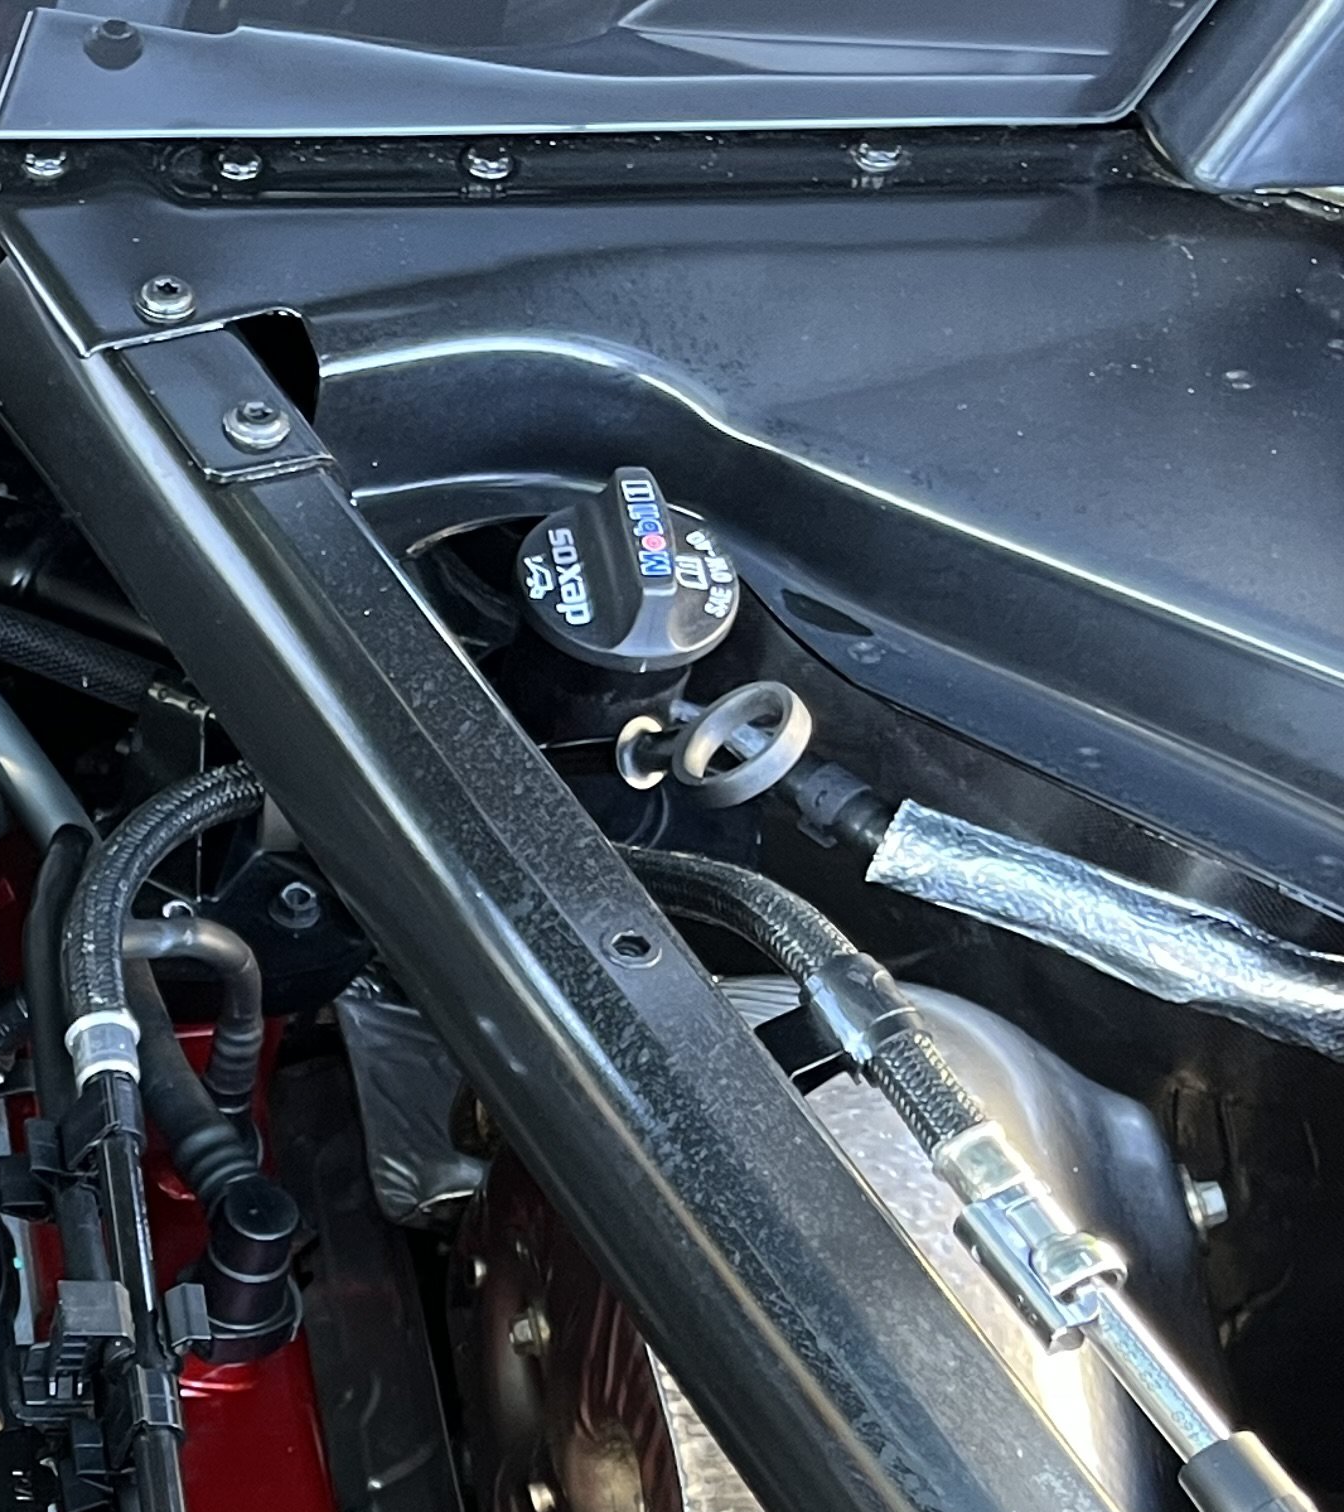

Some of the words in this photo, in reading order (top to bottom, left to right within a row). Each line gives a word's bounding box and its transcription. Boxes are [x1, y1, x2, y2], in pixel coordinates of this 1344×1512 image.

[623, 481, 653, 501] 1
[627, 503, 672, 576] Mobil
[548, 528, 592, 625] dexos
[705, 587, 732, 618] SAE
